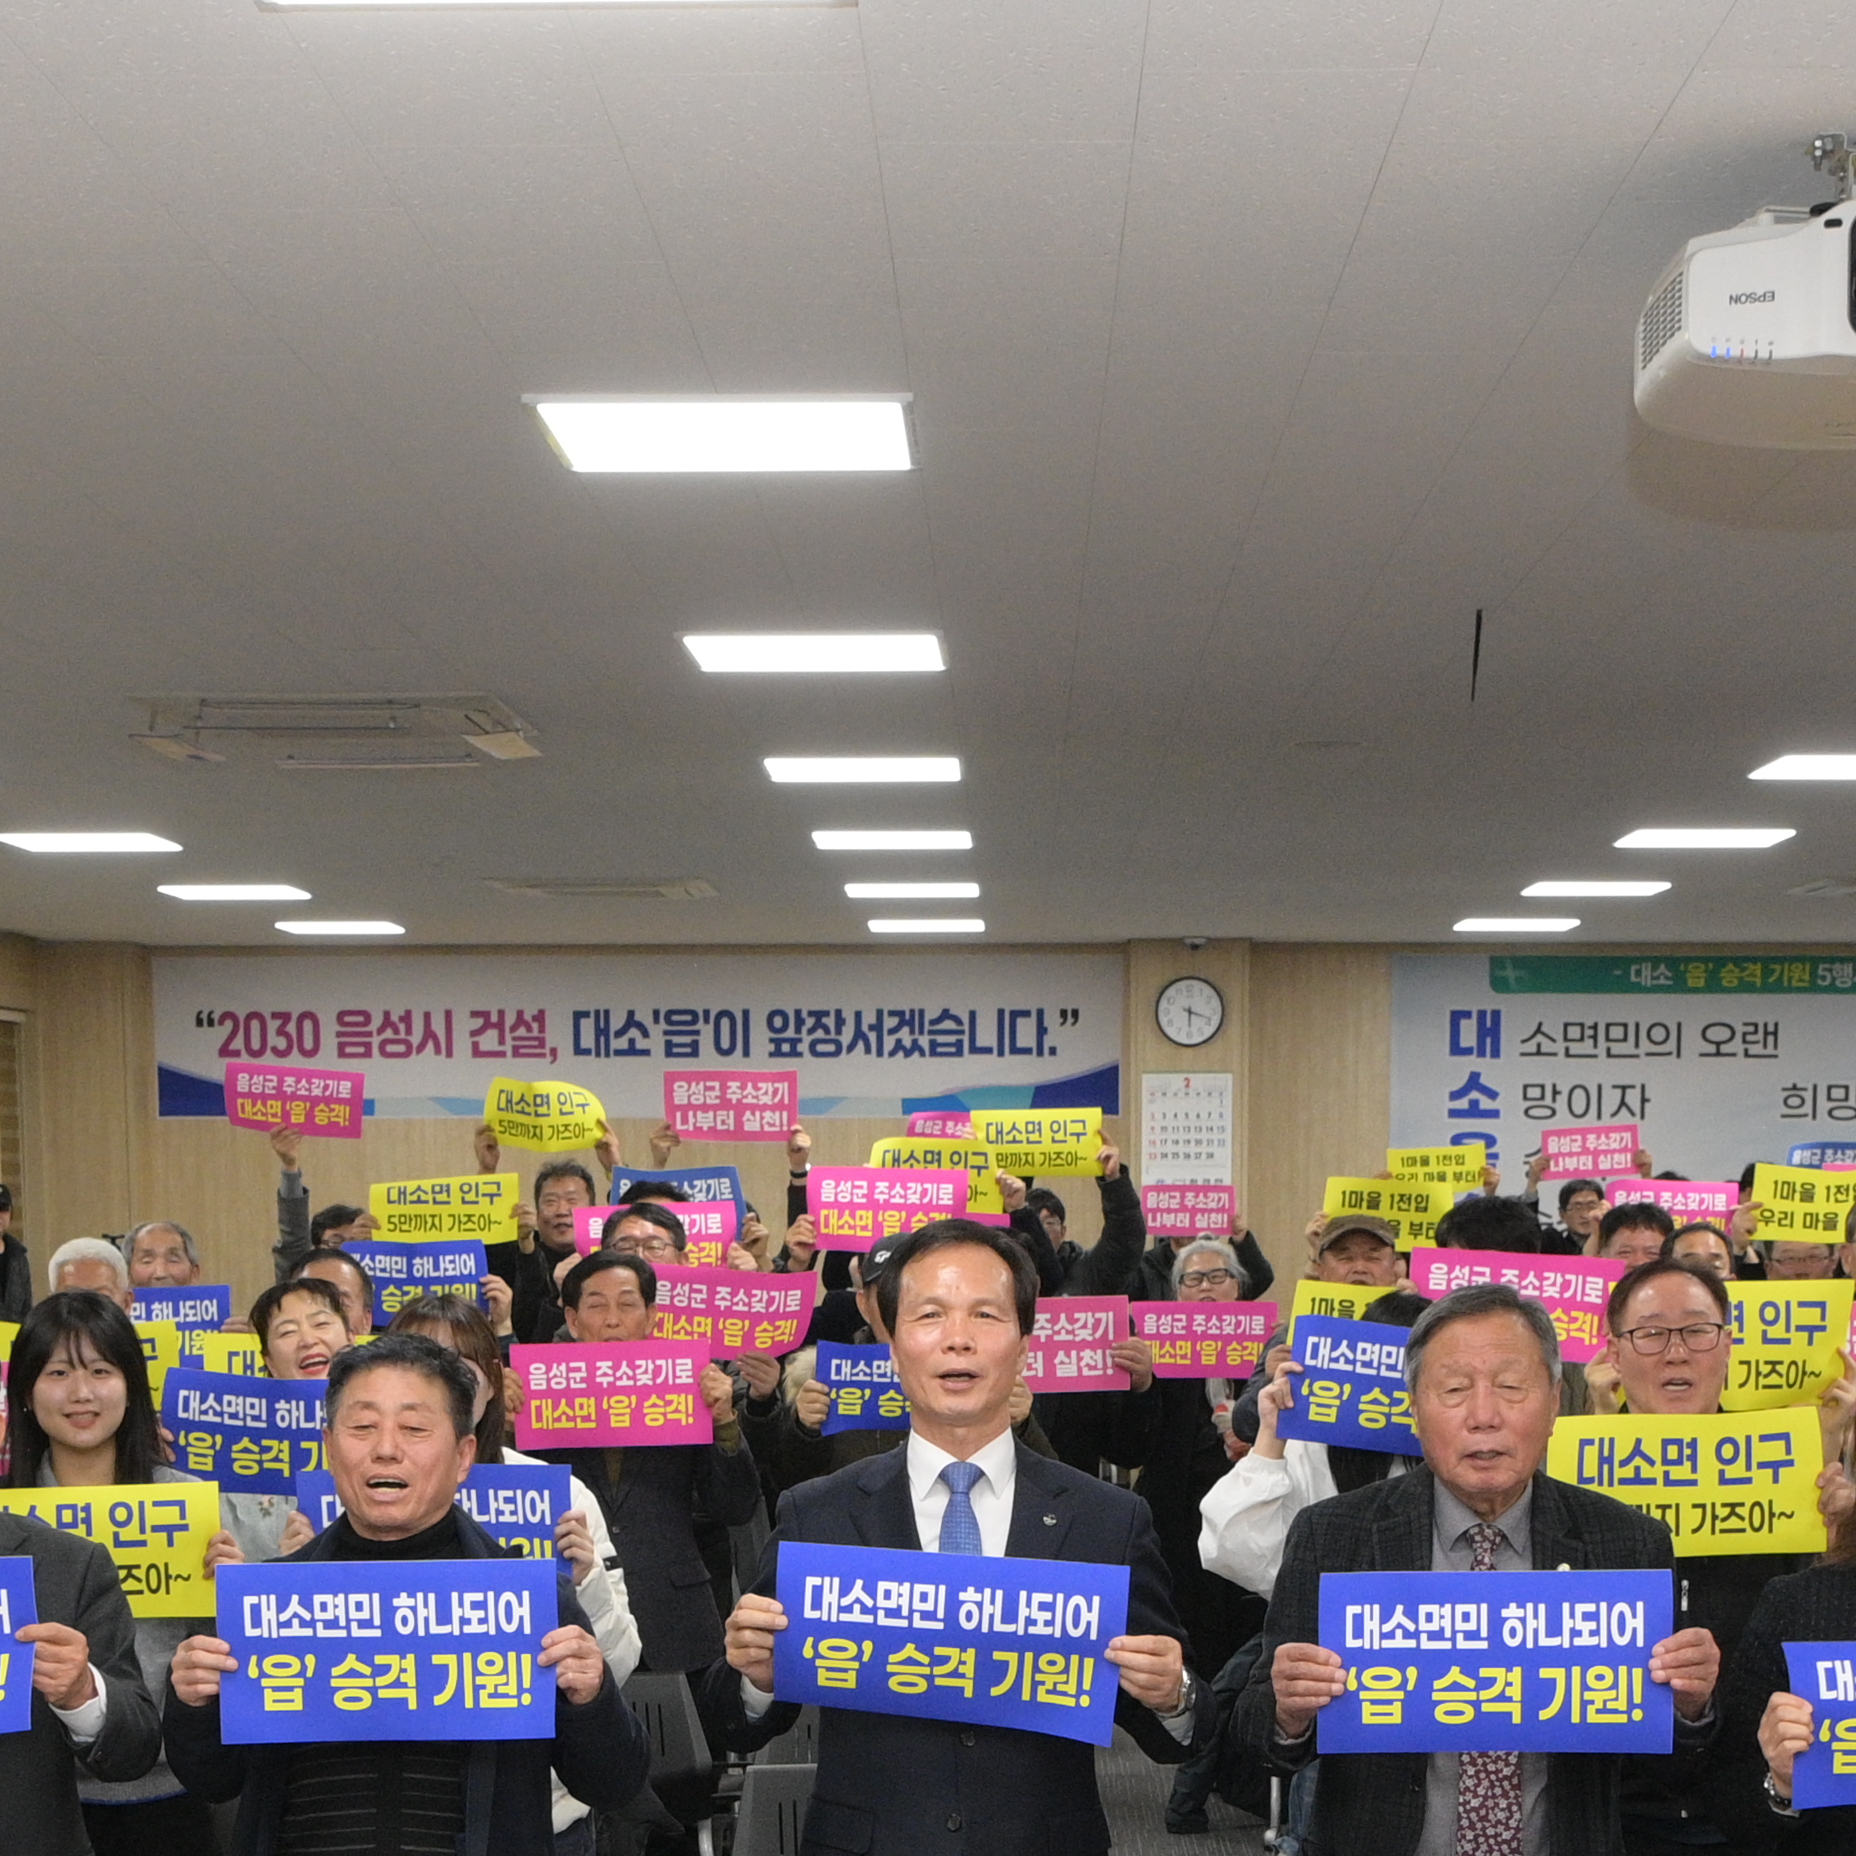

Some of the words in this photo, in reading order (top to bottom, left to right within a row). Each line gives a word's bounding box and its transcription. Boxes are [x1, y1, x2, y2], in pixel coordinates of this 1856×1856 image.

[1729, 290, 1775, 306] EPSON
[1630, 962, 1673, 987] 대소
[1719, 962, 1762, 988] 승격
[1769, 962, 1810, 987] 기원
[335, 1009, 455, 1059] 음성시
[469, 1008, 560, 1063] 건설,
[1449, 1009, 1502, 1059] 대
[1519, 1021, 1682, 1059] 소면민의
[1699, 1020, 1779, 1059] 오랜
[236, 1073, 277, 1094] 음성군
[282, 1076, 352, 1098] 주소갖기로
[672, 1081, 720, 1104] 음성군
[726, 1081, 789, 1104] 주소갖기
[1184, 1077, 1190, 1088] 2
[1447, 1070, 1501, 1119] 소
[1521, 1083, 1651, 1120] 망이자
[237, 1099, 282, 1124] 대소면
[313, 1103, 350, 1126] 승격!
[497, 1089, 551, 1118] 대소면
[557, 1091, 590, 1117] 인구
[498, 1122, 543, 1141] 5만까지
[676, 1111, 734, 1131] 나부터
[743, 1110, 788, 1131] 실천!
[985, 1122, 1043, 1145] 대소면
[1049, 1120, 1087, 1143] 인구
[1547, 1135, 1582, 1154] 음성군
[1585, 1132, 1632, 1151] 주소갖기
[1550, 1156, 1593, 1172] 나부터
[1598, 1153, 1631, 1170] 실천!
[386, 1183, 451, 1205] 대소면
[459, 1181, 502, 1205] 인구
[1146, 1192, 1180, 1210] 음성군
[1184, 1192, 1228, 1210] 주소갖기
[1341, 1190, 1381, 1211] 1마을
[1389, 1192, 1430, 1213] 1전입
[1772, 1180, 1817, 1203] 1마을
[387, 1213, 442, 1233] 5만까지
[1148, 1213, 1190, 1228] 나부터
[1195, 1212, 1228, 1229] 실천!
[1758, 1210, 1795, 1229] 우리
[1803, 1210, 1839, 1231] 마을
[655, 1280, 708, 1309] 음성군
[714, 1287, 801, 1314] 주소갖기로
[654, 1314, 712, 1343] 대소면
[754, 1320, 798, 1349] 승격!
[1144, 1314, 1186, 1335] 음성군
[1192, 1315, 1265, 1335] 주소갖기로
[1150, 1342, 1191, 1365] 대소면
[1226, 1343, 1264, 1365] 승격!
[528, 1363, 587, 1390] 음성군
[595, 1359, 694, 1387] 주소갖기로
[530, 1399, 596, 1430] 대소면
[643, 1394, 694, 1426] 승격!
[1577, 1436, 1699, 1488] 대소면
[1714, 1431, 1795, 1488] 인구
[243, 1593, 381, 1638] 대소면민
[393, 1590, 531, 1637] 하나되어
[803, 1576, 945, 1630] 대소면민
[958, 1586, 1100, 1640] 하나되어
[1345, 1603, 1488, 1650] 대소면민
[1502, 1601, 1644, 1649] 하나되어
[330, 1654, 417, 1711] 승격
[432, 1652, 532, 1709] 기원!
[886, 1643, 974, 1698] 승격
[990, 1650, 1094, 1707] 기원!
[1431, 1666, 1521, 1724] 승격
[1538, 1665, 1643, 1724] 기원!
